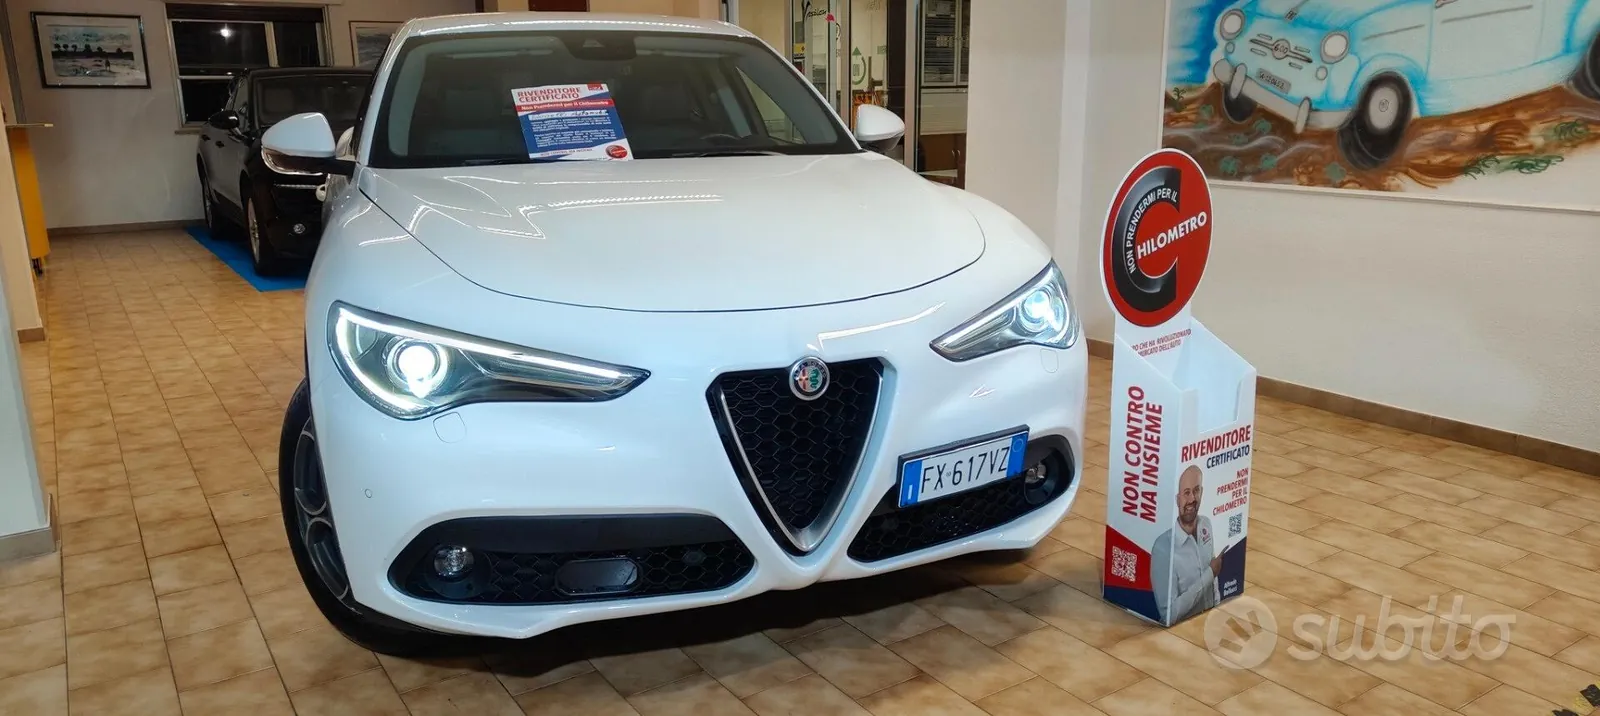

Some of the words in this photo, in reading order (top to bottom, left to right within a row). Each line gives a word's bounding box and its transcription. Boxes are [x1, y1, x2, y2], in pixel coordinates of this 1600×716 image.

[518, 86, 581, 98] RIVENDITORE
[518, 93, 580, 103] CERTIFICATO
[1157, 188, 1171, 199] PER
[1172, 191, 1178, 203] IL
[1126, 192, 1156, 247] PRENDERMI
[1126, 252, 1136, 274] NON
[1157, 329, 1192, 344] RIVOLUZIONATO
[1124, 386, 1144, 467] CONTRO
[1142, 402, 1162, 486] INSIEME
[1181, 425, 1251, 463] RIVENDITORE
[1206, 445, 1250, 469] CERTIFICATO
[1236, 468, 1249, 479] NON
[1122, 471, 1140, 516] NON
[1217, 478, 1248, 496] PRENDERMI
[1232, 489, 1242, 499] PER
[1243, 487, 1248, 496] IL
[1140, 491, 1157, 523] MA
[1213, 496, 1247, 516] CHILOMETRO
